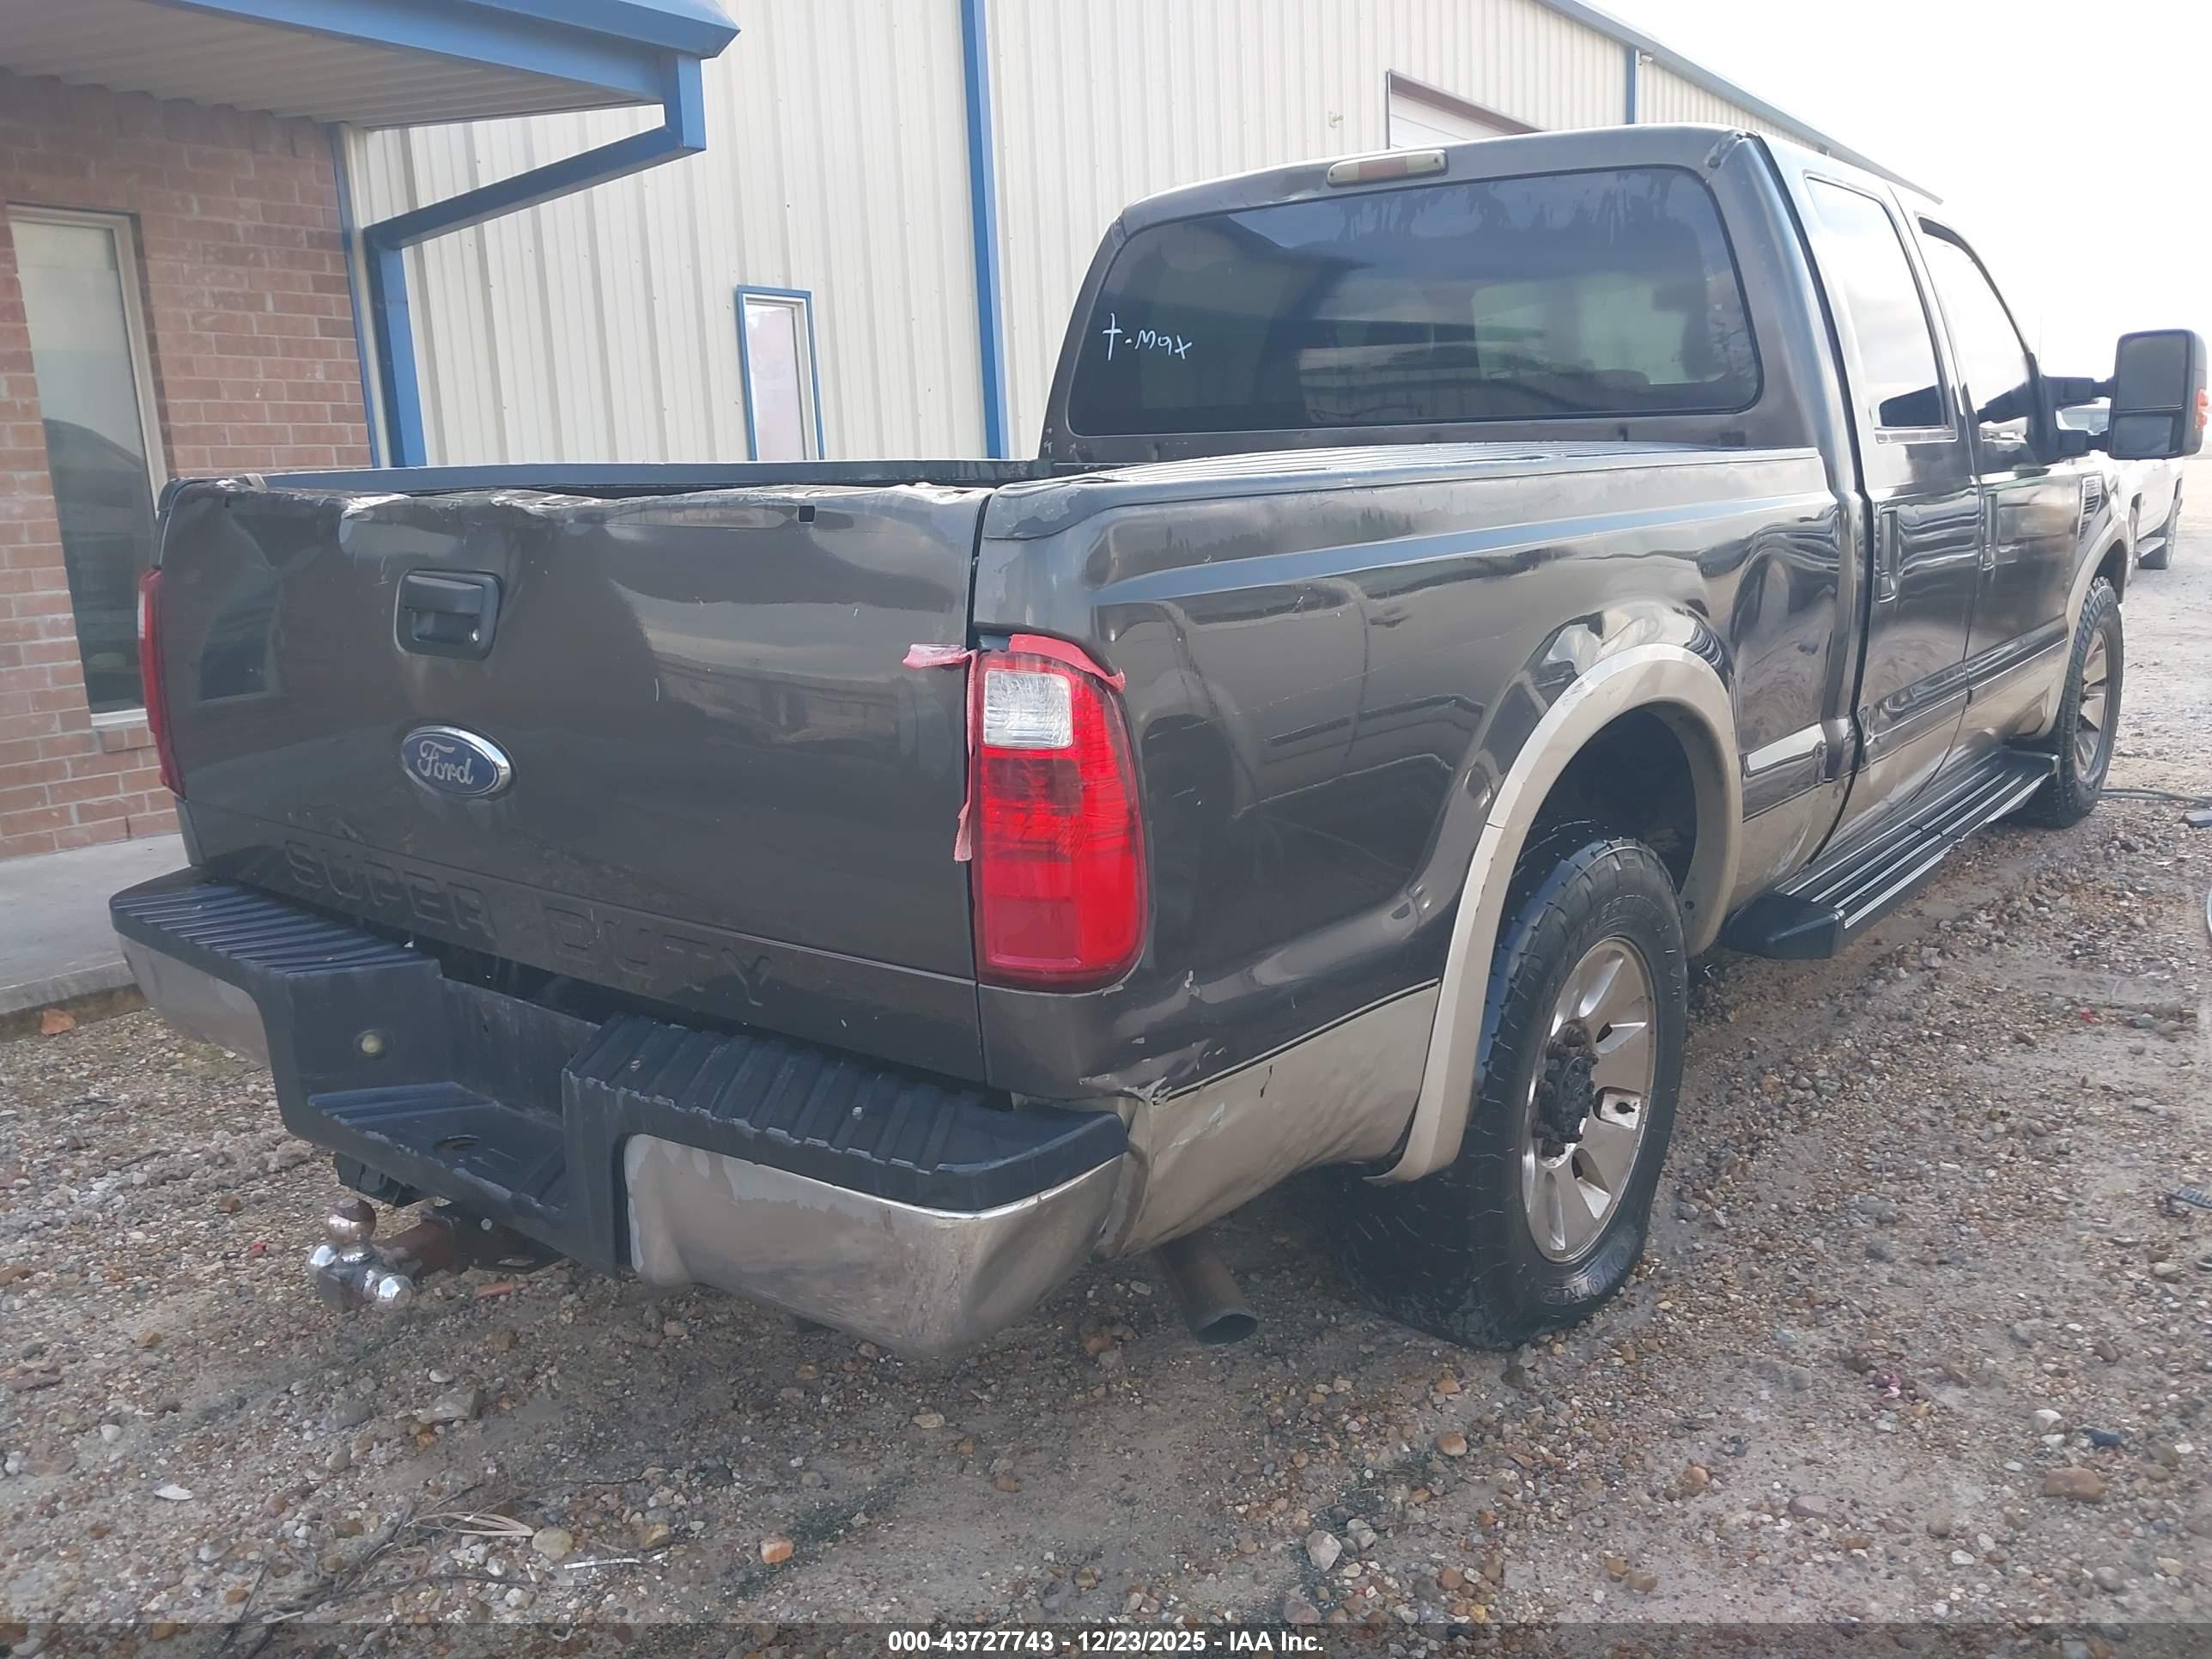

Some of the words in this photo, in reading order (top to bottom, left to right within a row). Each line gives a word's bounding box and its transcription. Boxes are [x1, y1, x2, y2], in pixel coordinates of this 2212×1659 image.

[417, 739, 474, 785] Ford
[283, 838, 500, 943] SUPER
[542, 896, 774, 1008] DUTY
